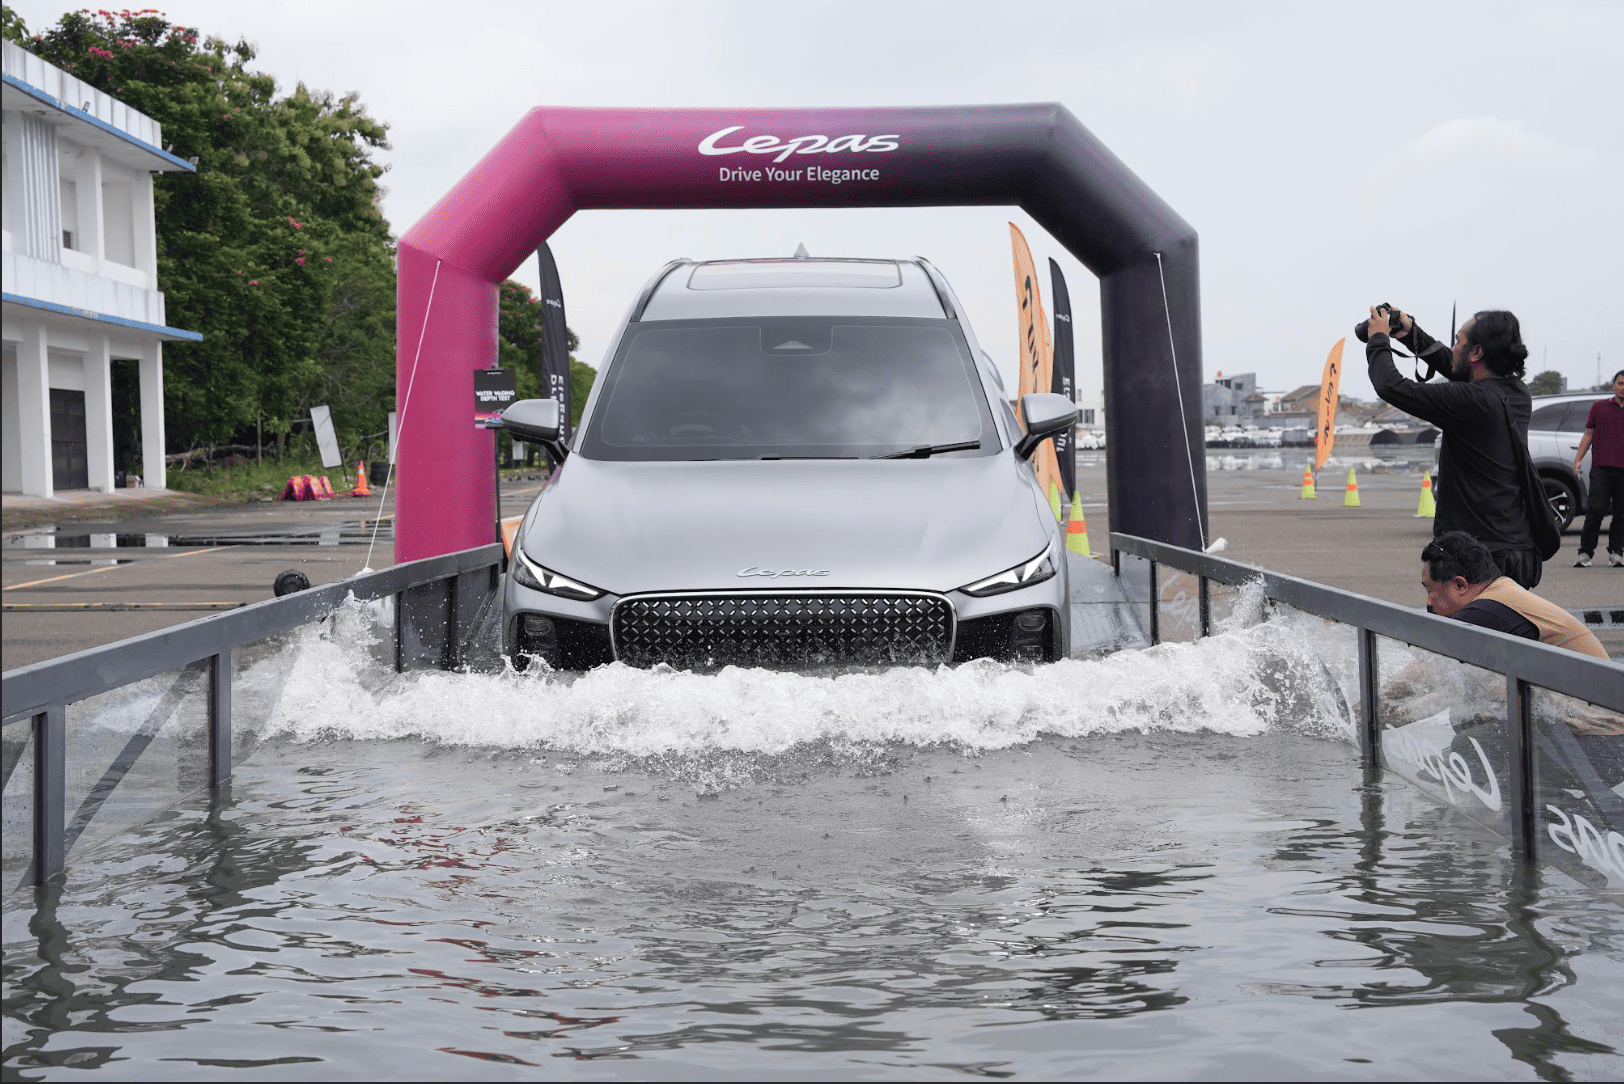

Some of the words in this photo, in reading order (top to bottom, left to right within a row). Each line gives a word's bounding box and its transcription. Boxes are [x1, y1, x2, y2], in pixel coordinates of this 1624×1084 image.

[698, 126, 900, 162] Lepas
[719, 167, 762, 182] Drive
[765, 167, 803, 182] Your
[807, 166, 880, 184] Elegance
[736, 566, 830, 579] Lepas
